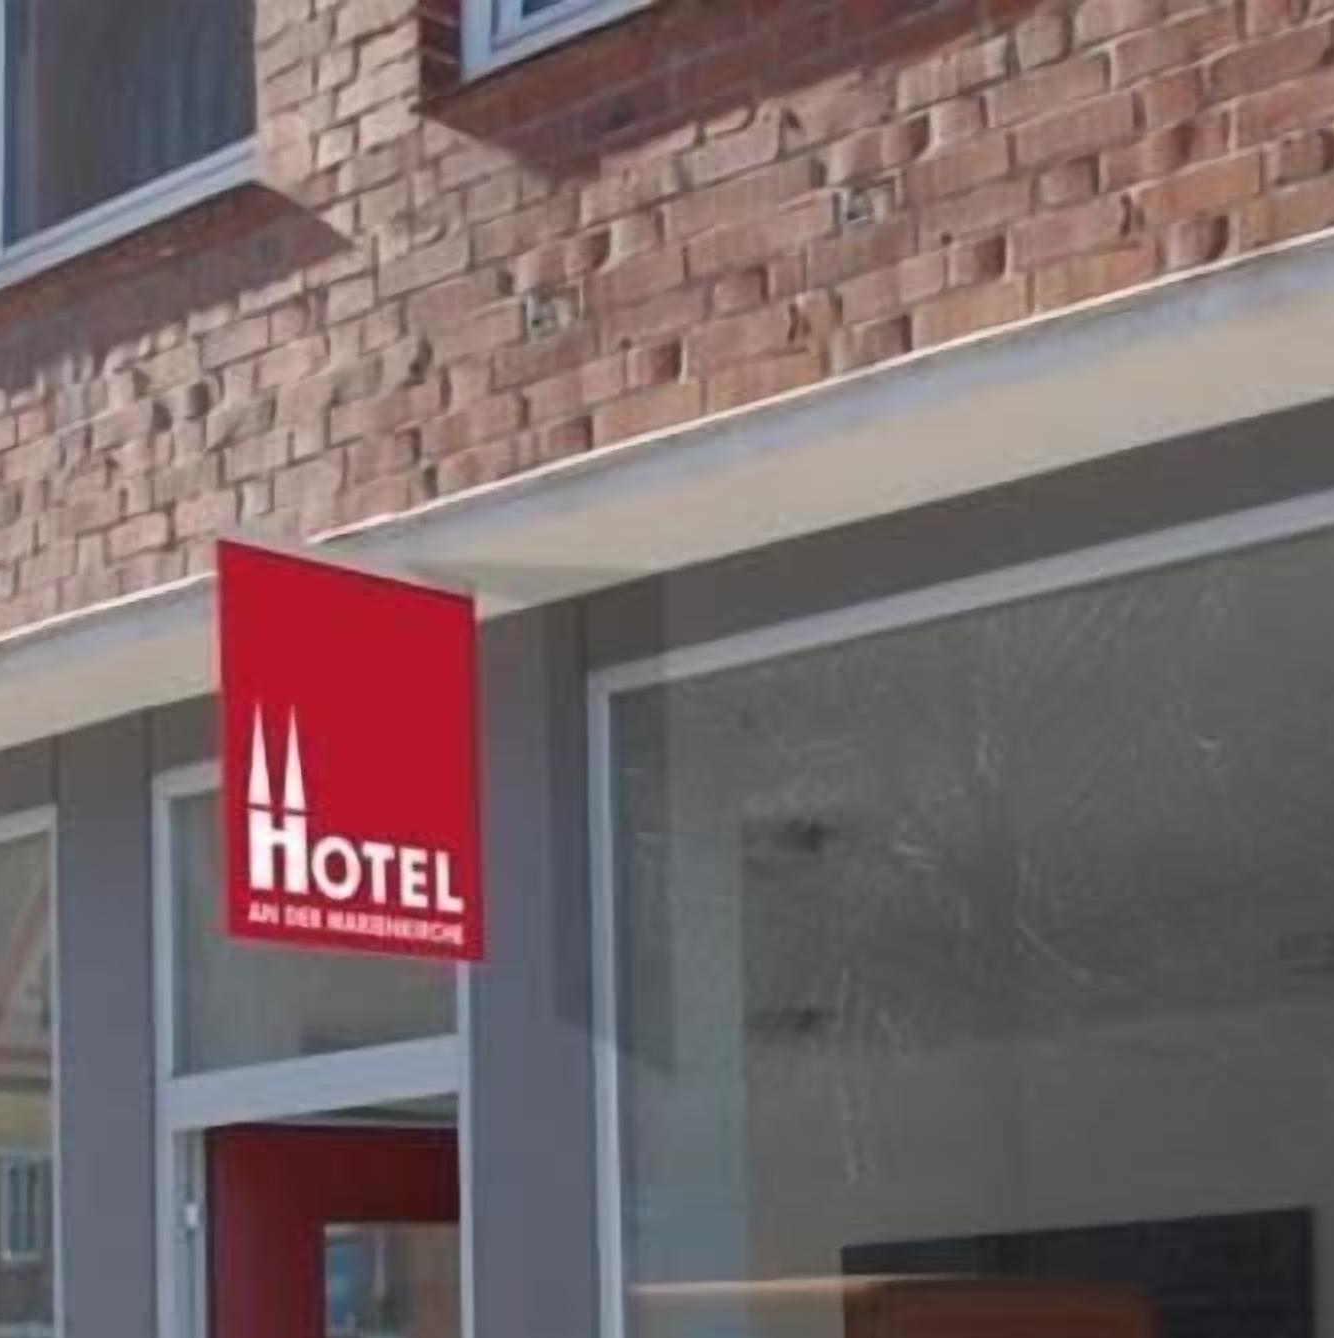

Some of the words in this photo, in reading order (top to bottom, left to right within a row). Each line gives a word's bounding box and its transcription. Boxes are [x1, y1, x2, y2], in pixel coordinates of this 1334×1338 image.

[249, 808, 465, 915] HOTEL
[248, 901, 279, 924] AN
[285, 904, 321, 928] DER
